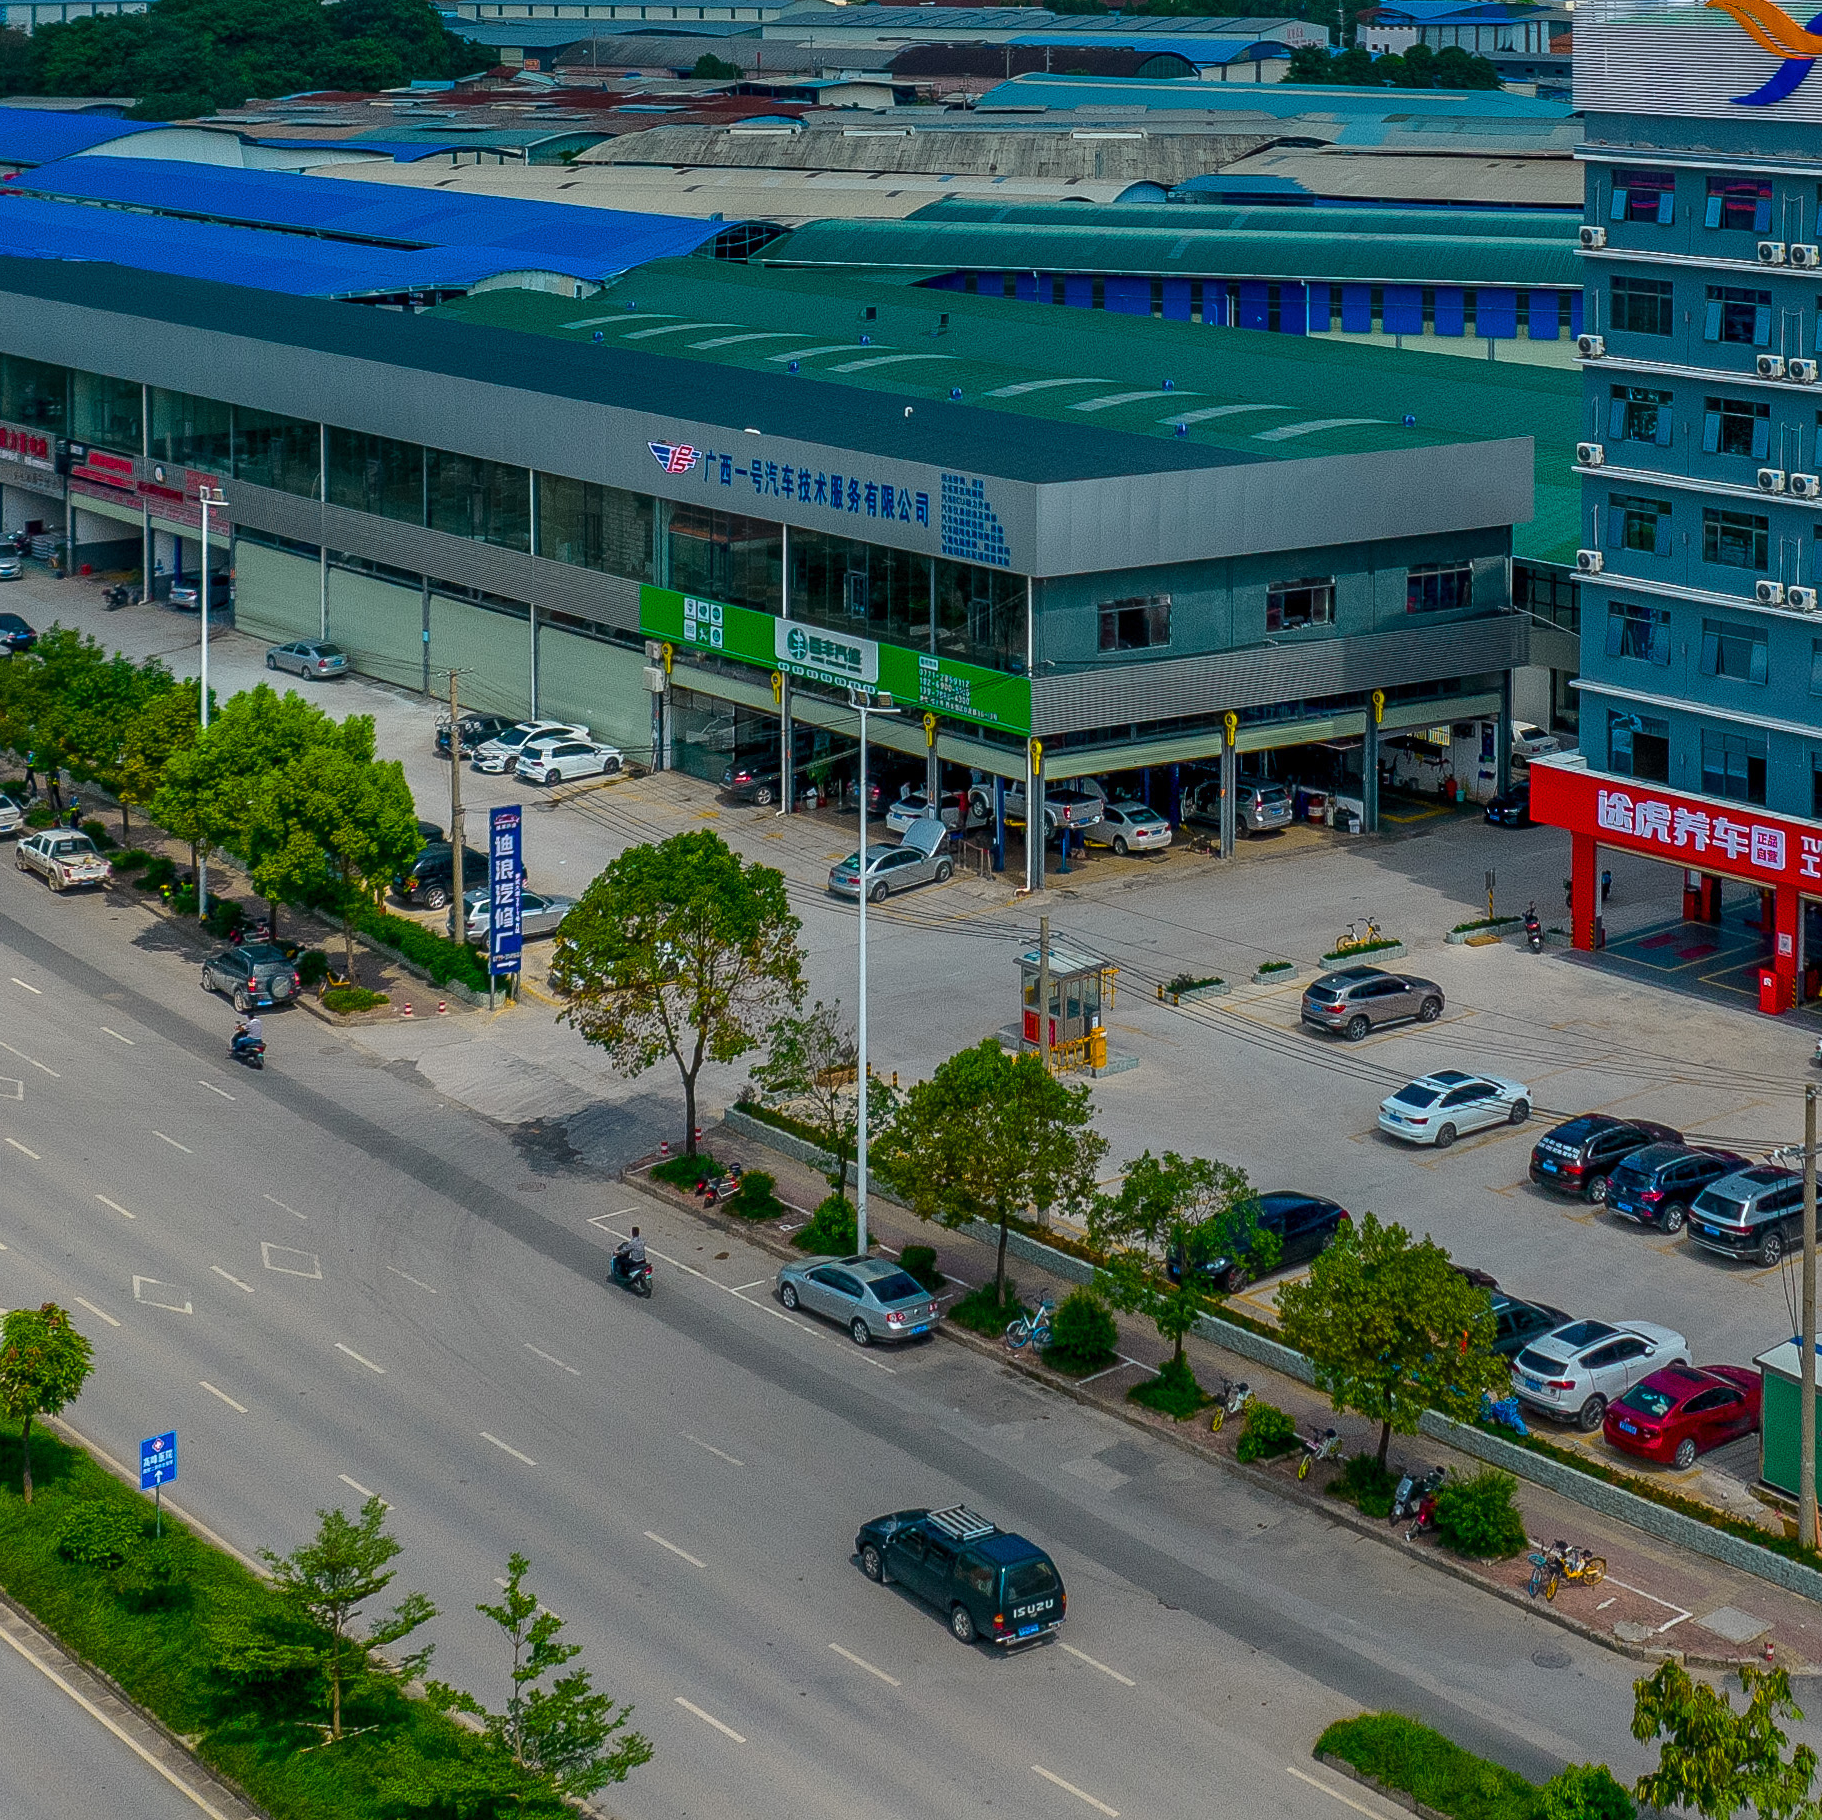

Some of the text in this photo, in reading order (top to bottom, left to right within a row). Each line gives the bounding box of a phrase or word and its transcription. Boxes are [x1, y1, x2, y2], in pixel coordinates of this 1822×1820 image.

[703, 449, 929, 527] 广西一号汽车技术服务有限公司
[1598, 790, 1749, 859] 途虎养车
[1013, 1598, 1054, 1619] ISUZU
